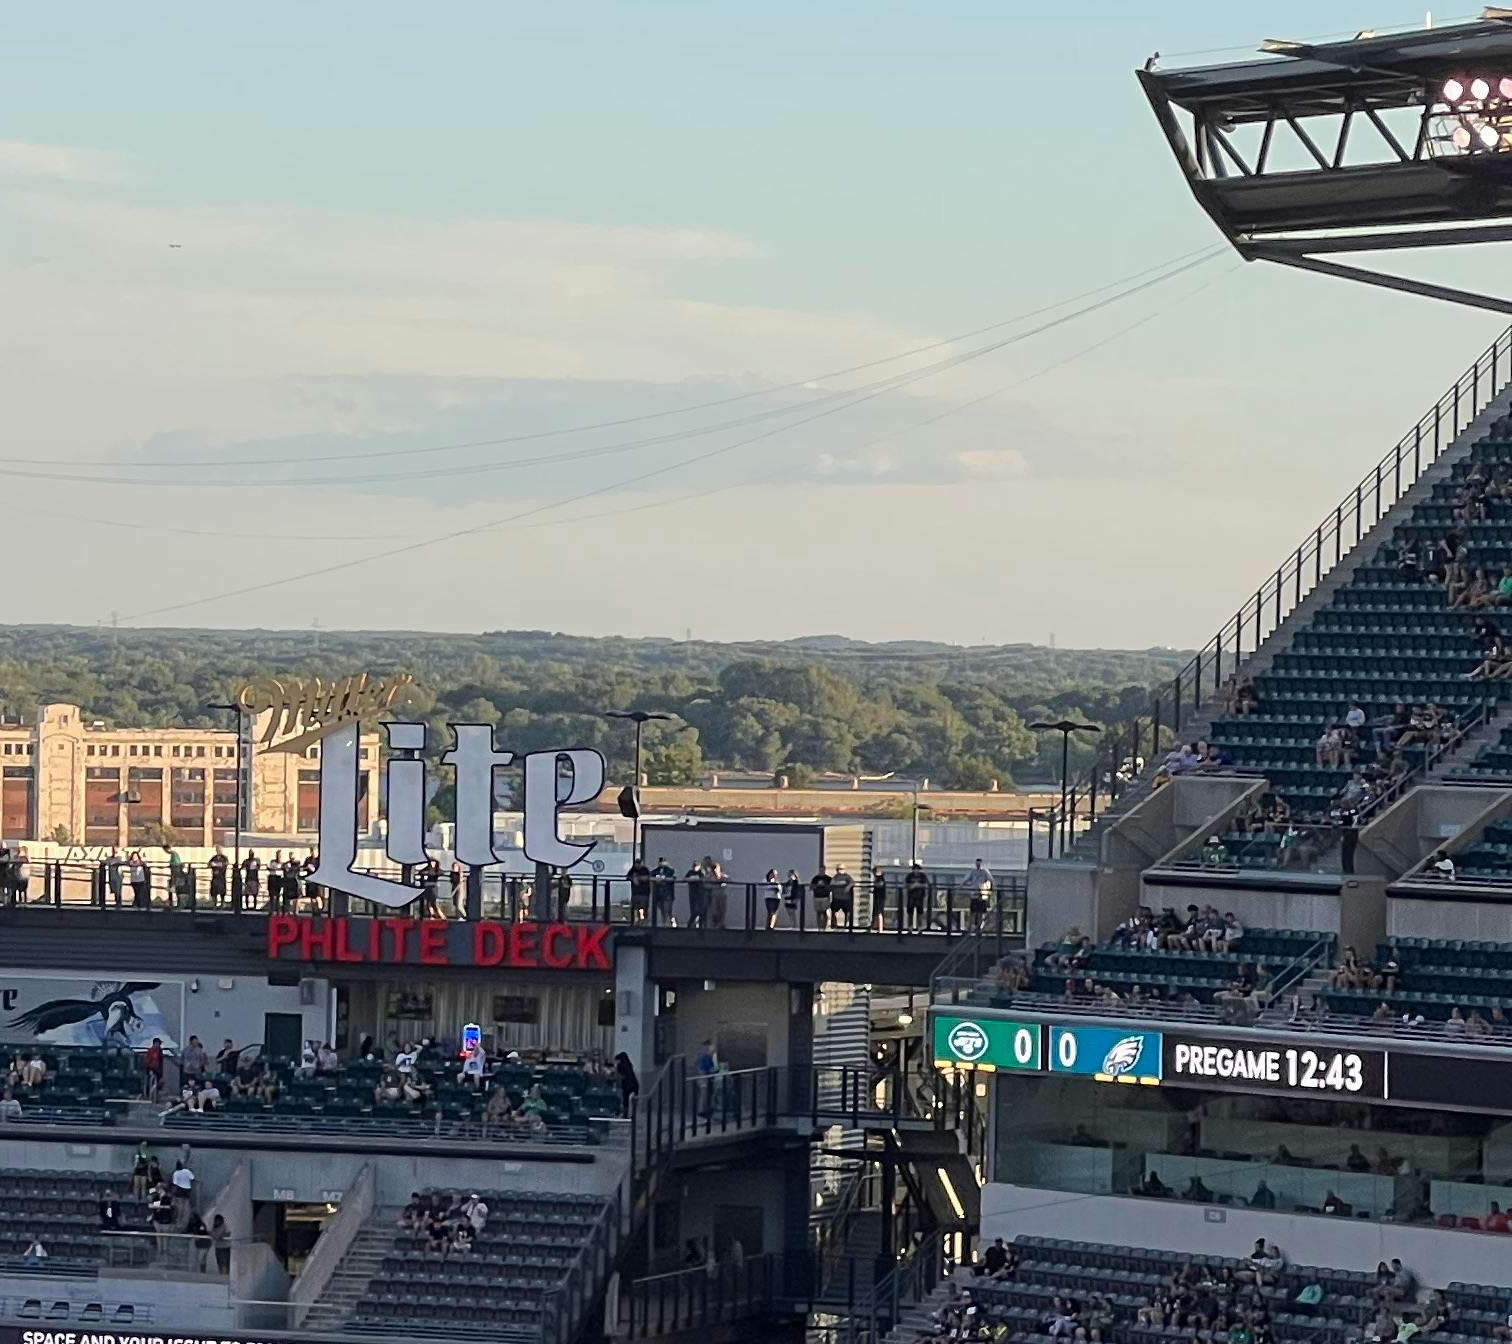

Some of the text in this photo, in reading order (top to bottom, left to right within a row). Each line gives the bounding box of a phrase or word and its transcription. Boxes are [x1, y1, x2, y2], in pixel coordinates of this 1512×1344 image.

[238, 672, 414, 754] Miller
[305, 720, 607, 909] Lite
[267, 914, 613, 970] PHLITE DECK
[1013, 1028, 1033, 1064] 0
[1058, 1031, 1077, 1067] 0
[1175, 1044, 1364, 1092] PREGAME 12:43
